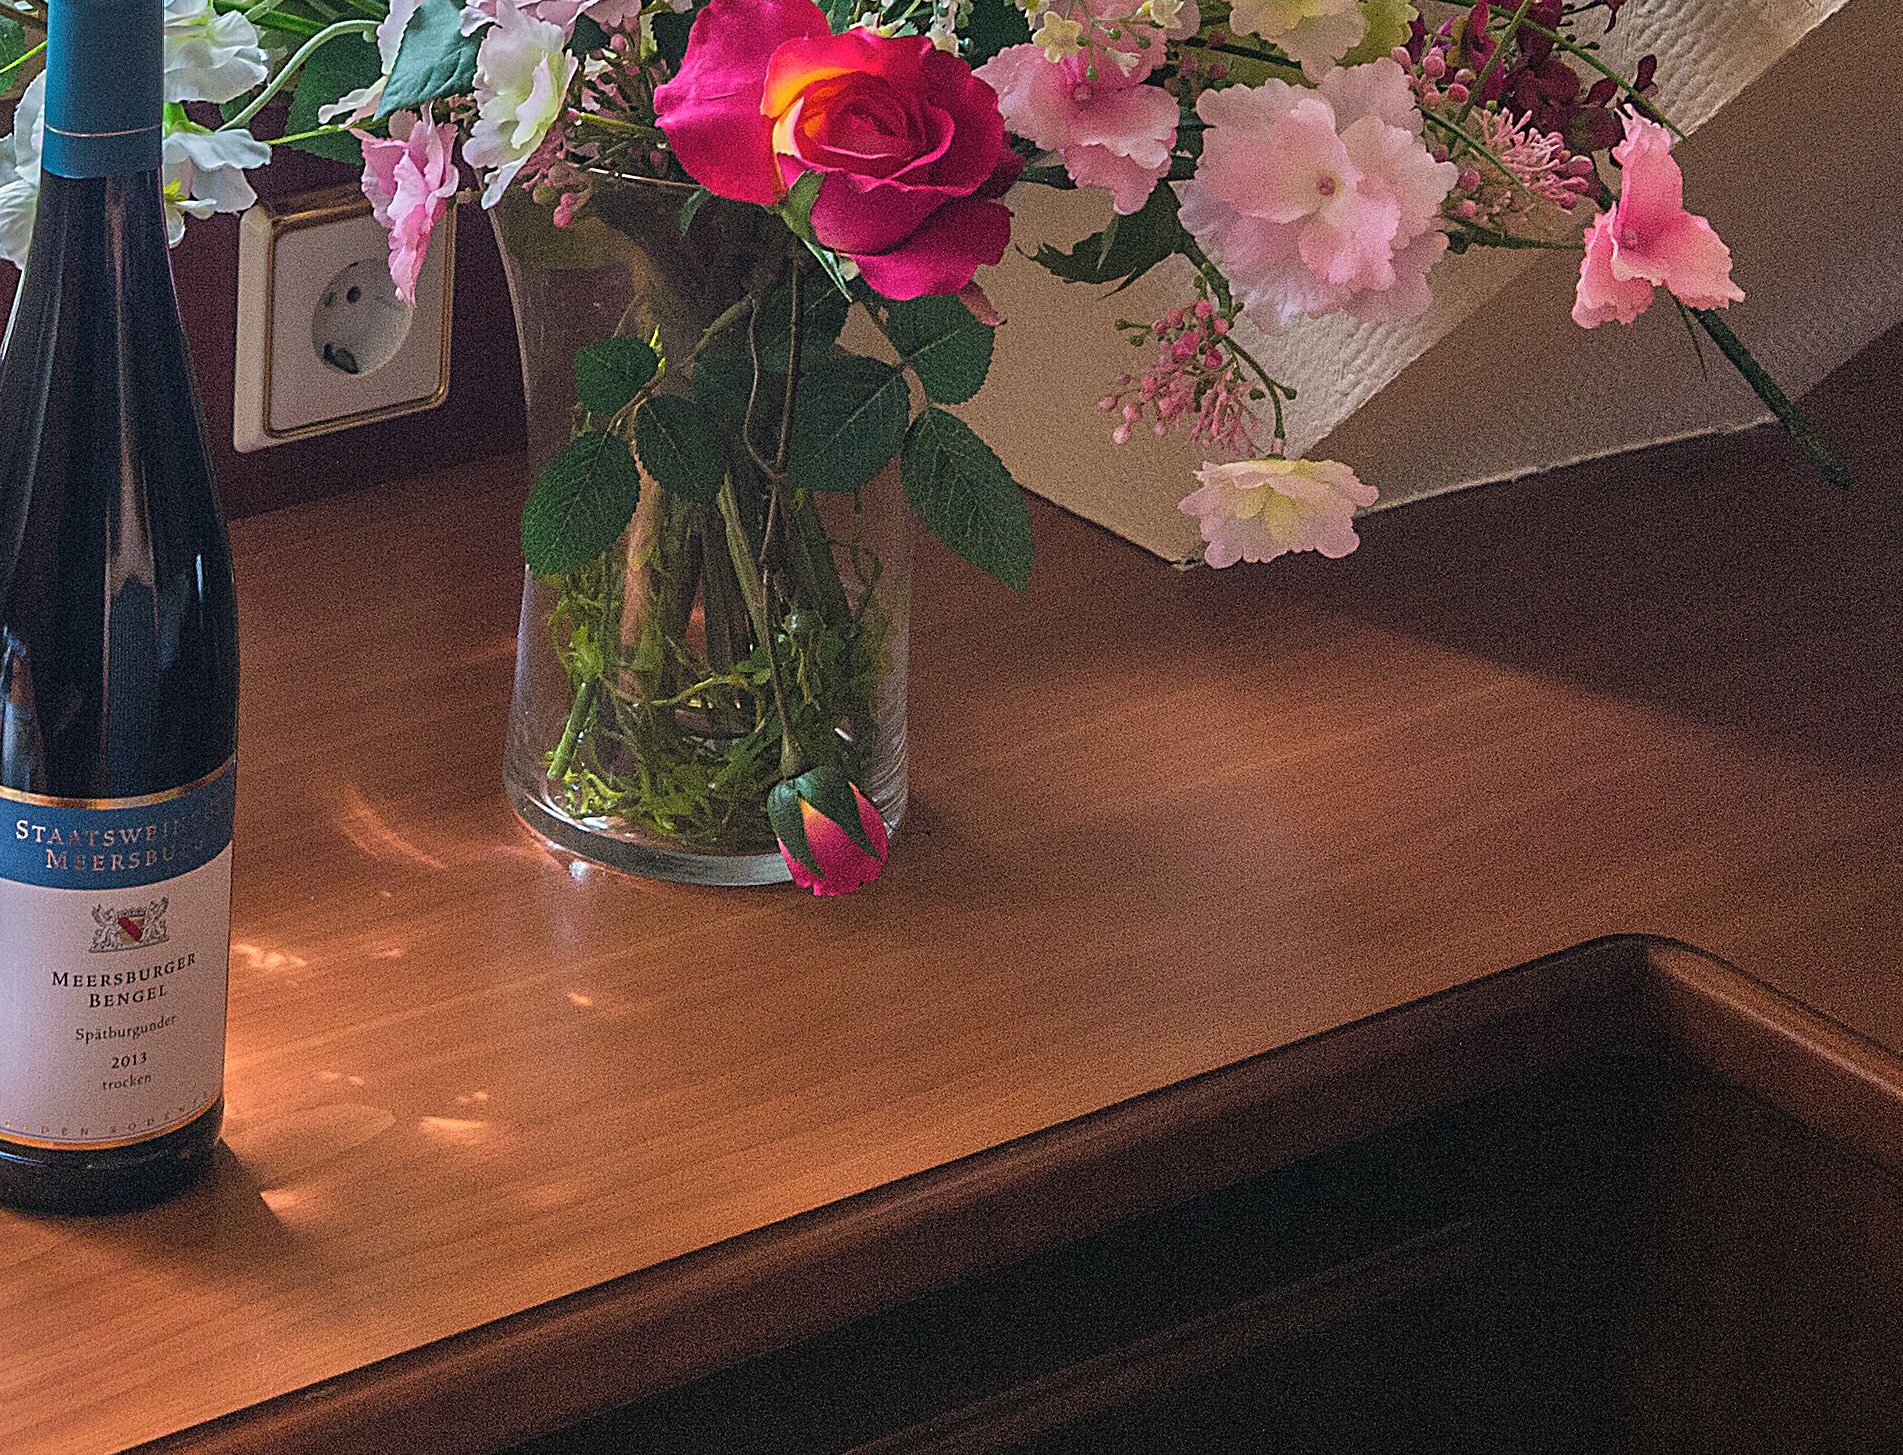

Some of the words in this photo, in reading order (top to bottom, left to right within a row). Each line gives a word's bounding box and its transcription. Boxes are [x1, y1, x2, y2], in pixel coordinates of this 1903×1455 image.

[52, 953, 195, 987] MEERSBURGER
[89, 984, 167, 1009] BENGEL
[75, 1015, 177, 1044] Spätburgunder
[111, 1052, 148, 1069] 2013
[102, 1074, 152, 1091] trocken
